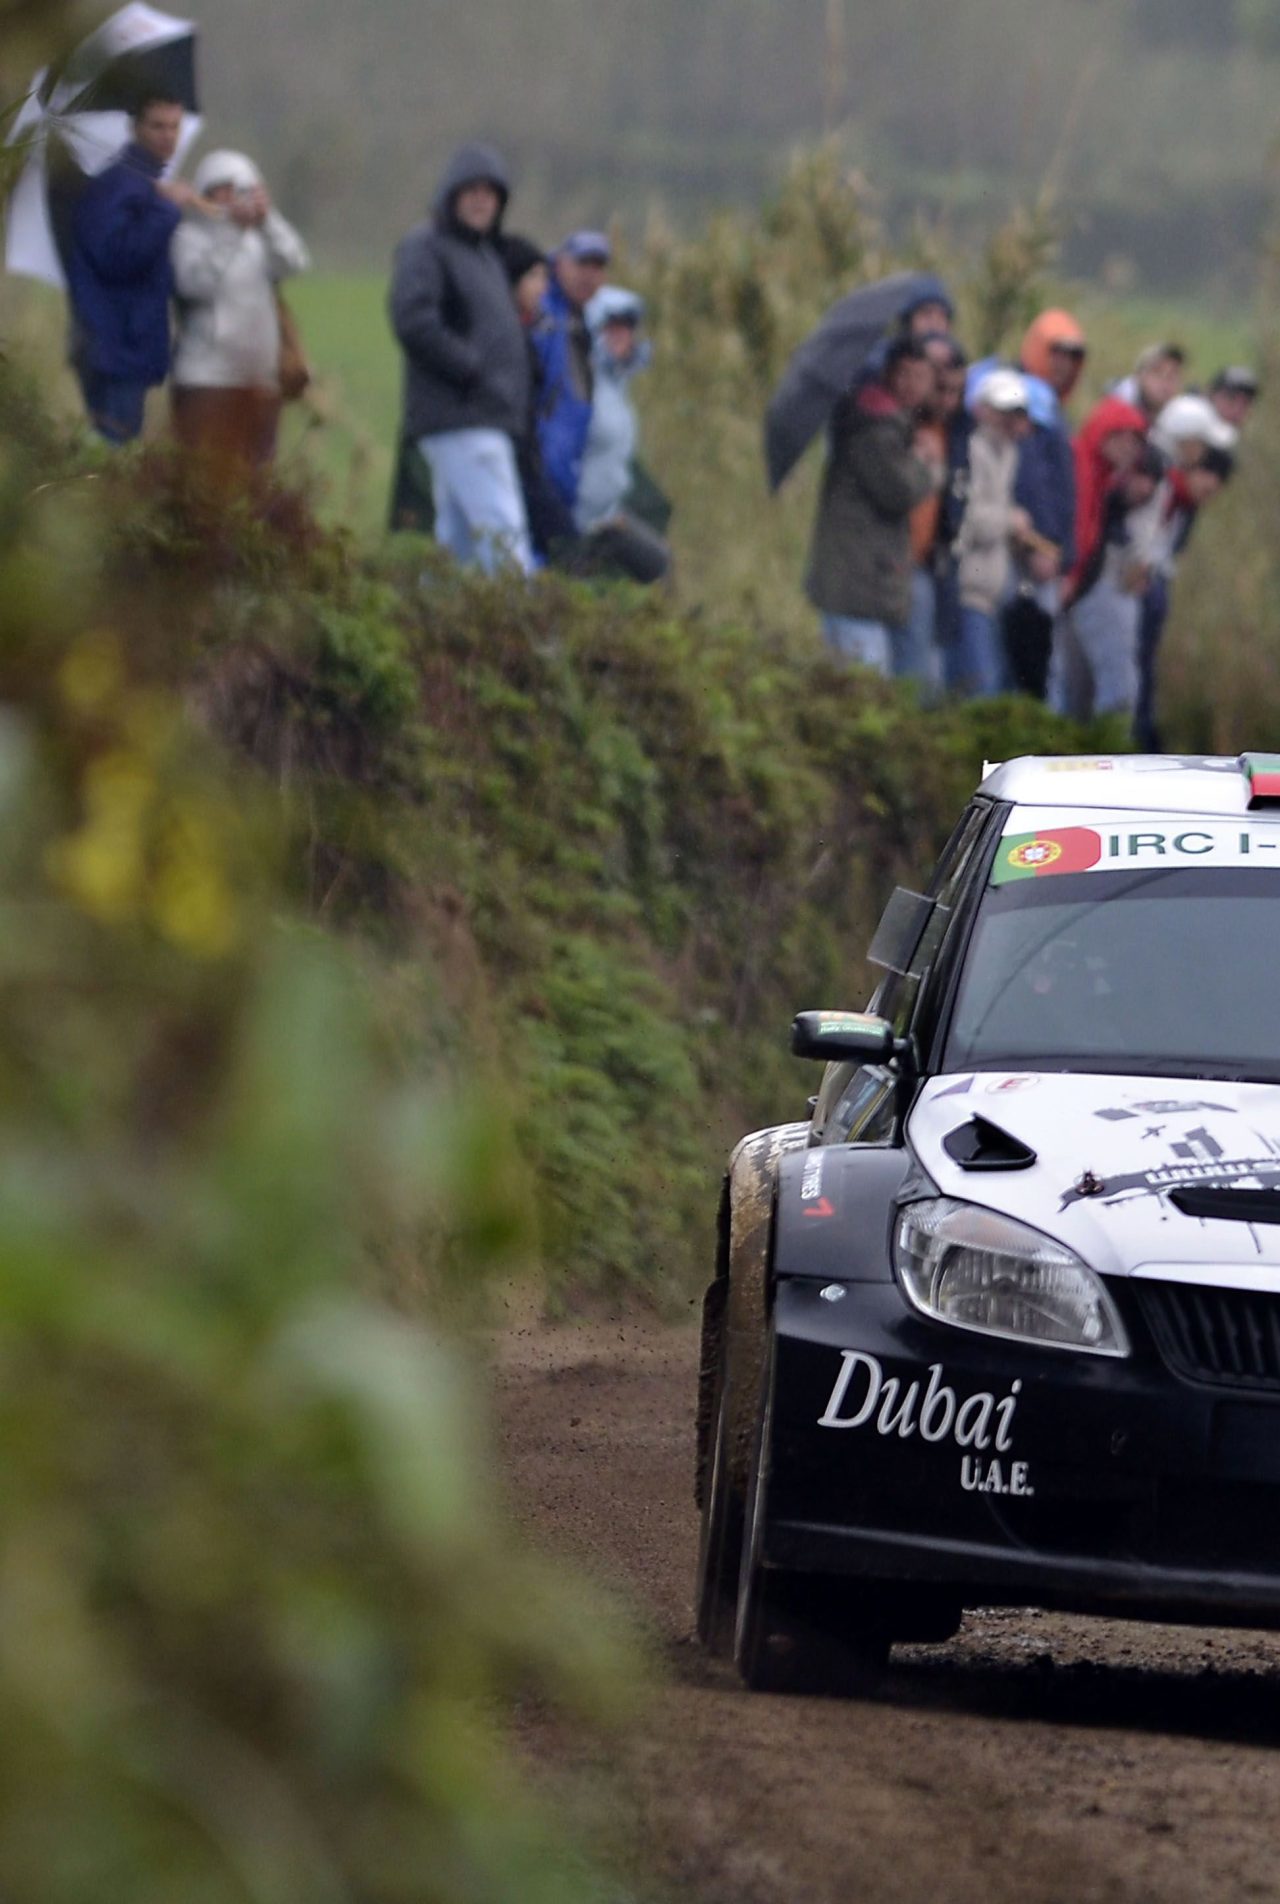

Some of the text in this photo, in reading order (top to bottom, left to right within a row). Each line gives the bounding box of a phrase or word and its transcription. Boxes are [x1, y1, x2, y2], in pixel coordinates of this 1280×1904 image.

[1108, 832, 1214, 857] IRC
[817, 1350, 1022, 1452] Dubai
[961, 1455, 1034, 1496] U.A.E.
